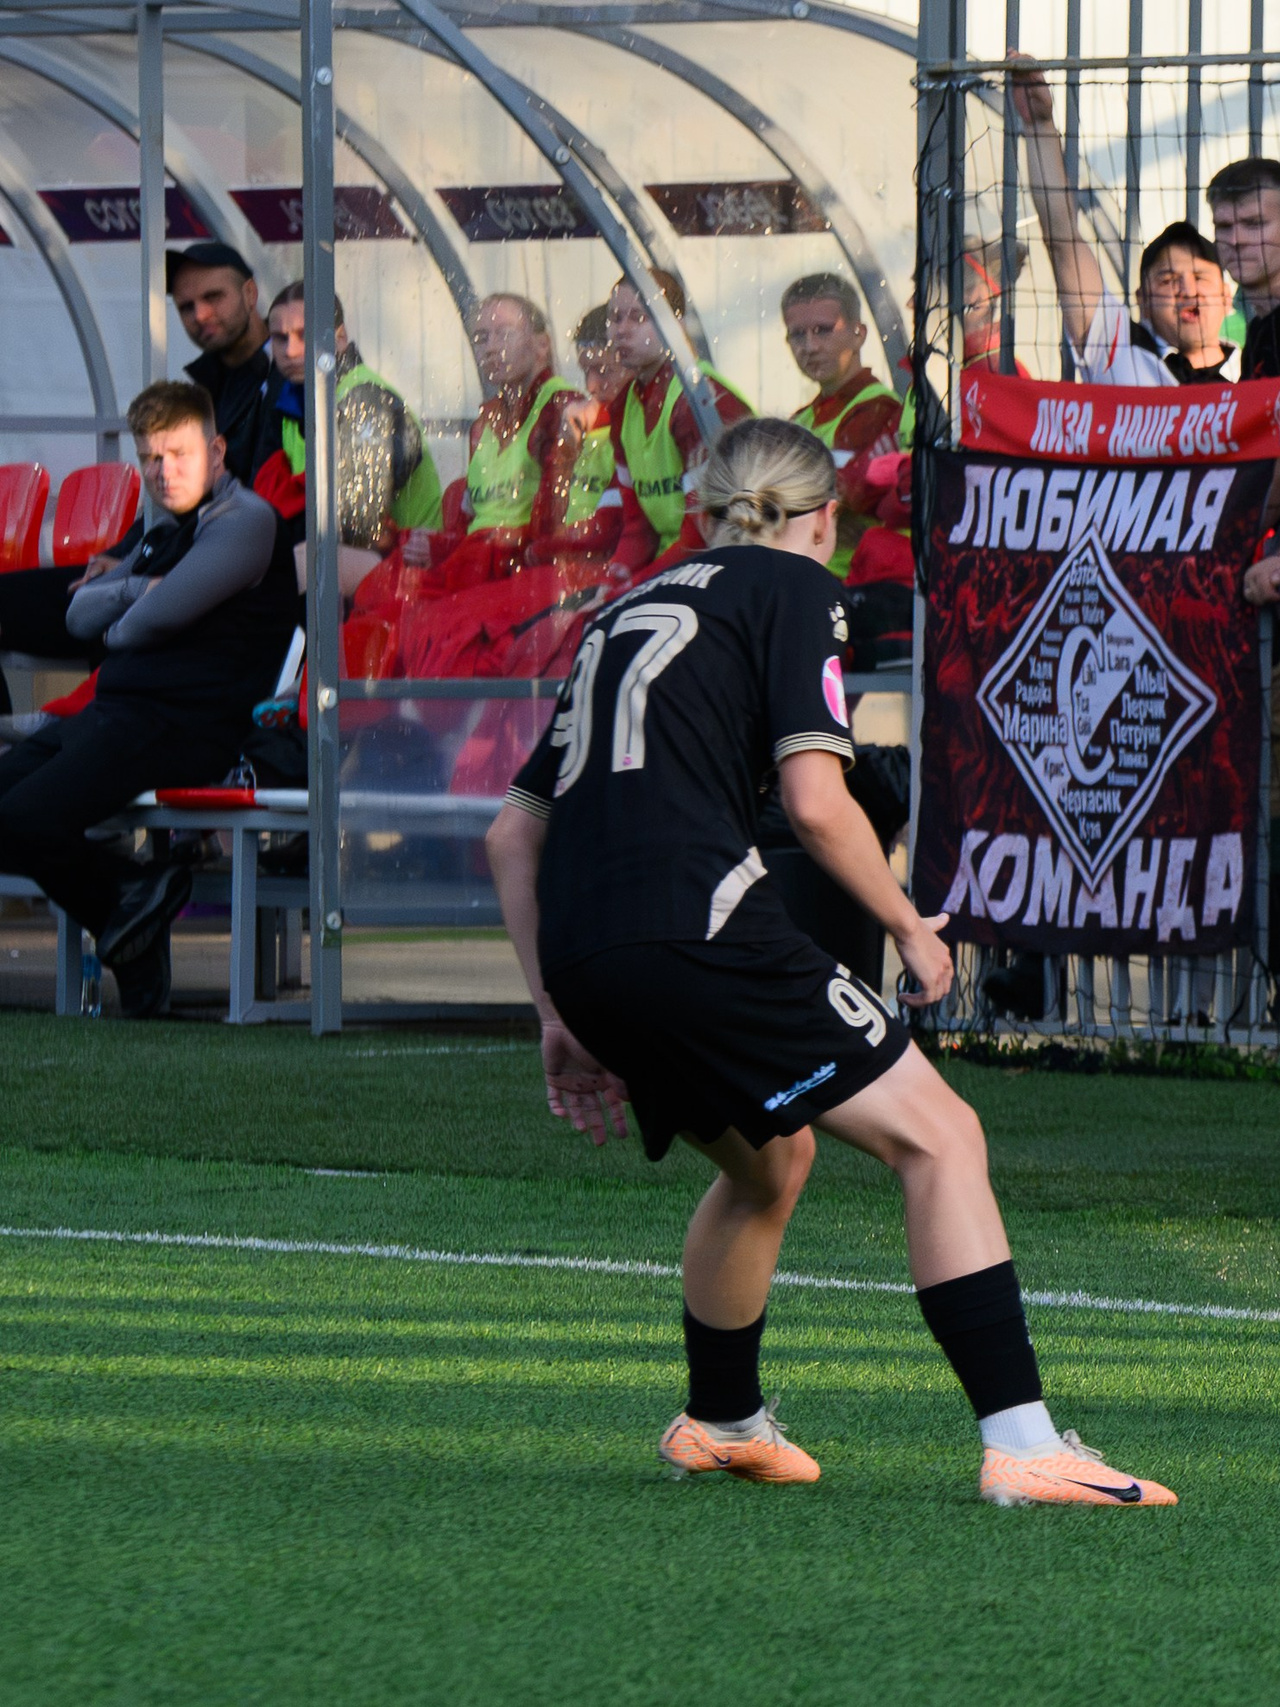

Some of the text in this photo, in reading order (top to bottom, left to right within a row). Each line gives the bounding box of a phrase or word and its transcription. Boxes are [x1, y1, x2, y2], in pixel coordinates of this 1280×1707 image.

[1030, 399, 1092, 454] ЛИЗА
[1108, 404, 1180, 458] НАШЕ
[1178, 391, 1239, 455] ВСЁ!
[949, 464, 1236, 552] ЛЮБИМАЯ
[550, 602, 698, 798] 97
[1003, 702, 1068, 748] Марина
[942, 829, 1243, 941] КОМАНДА
